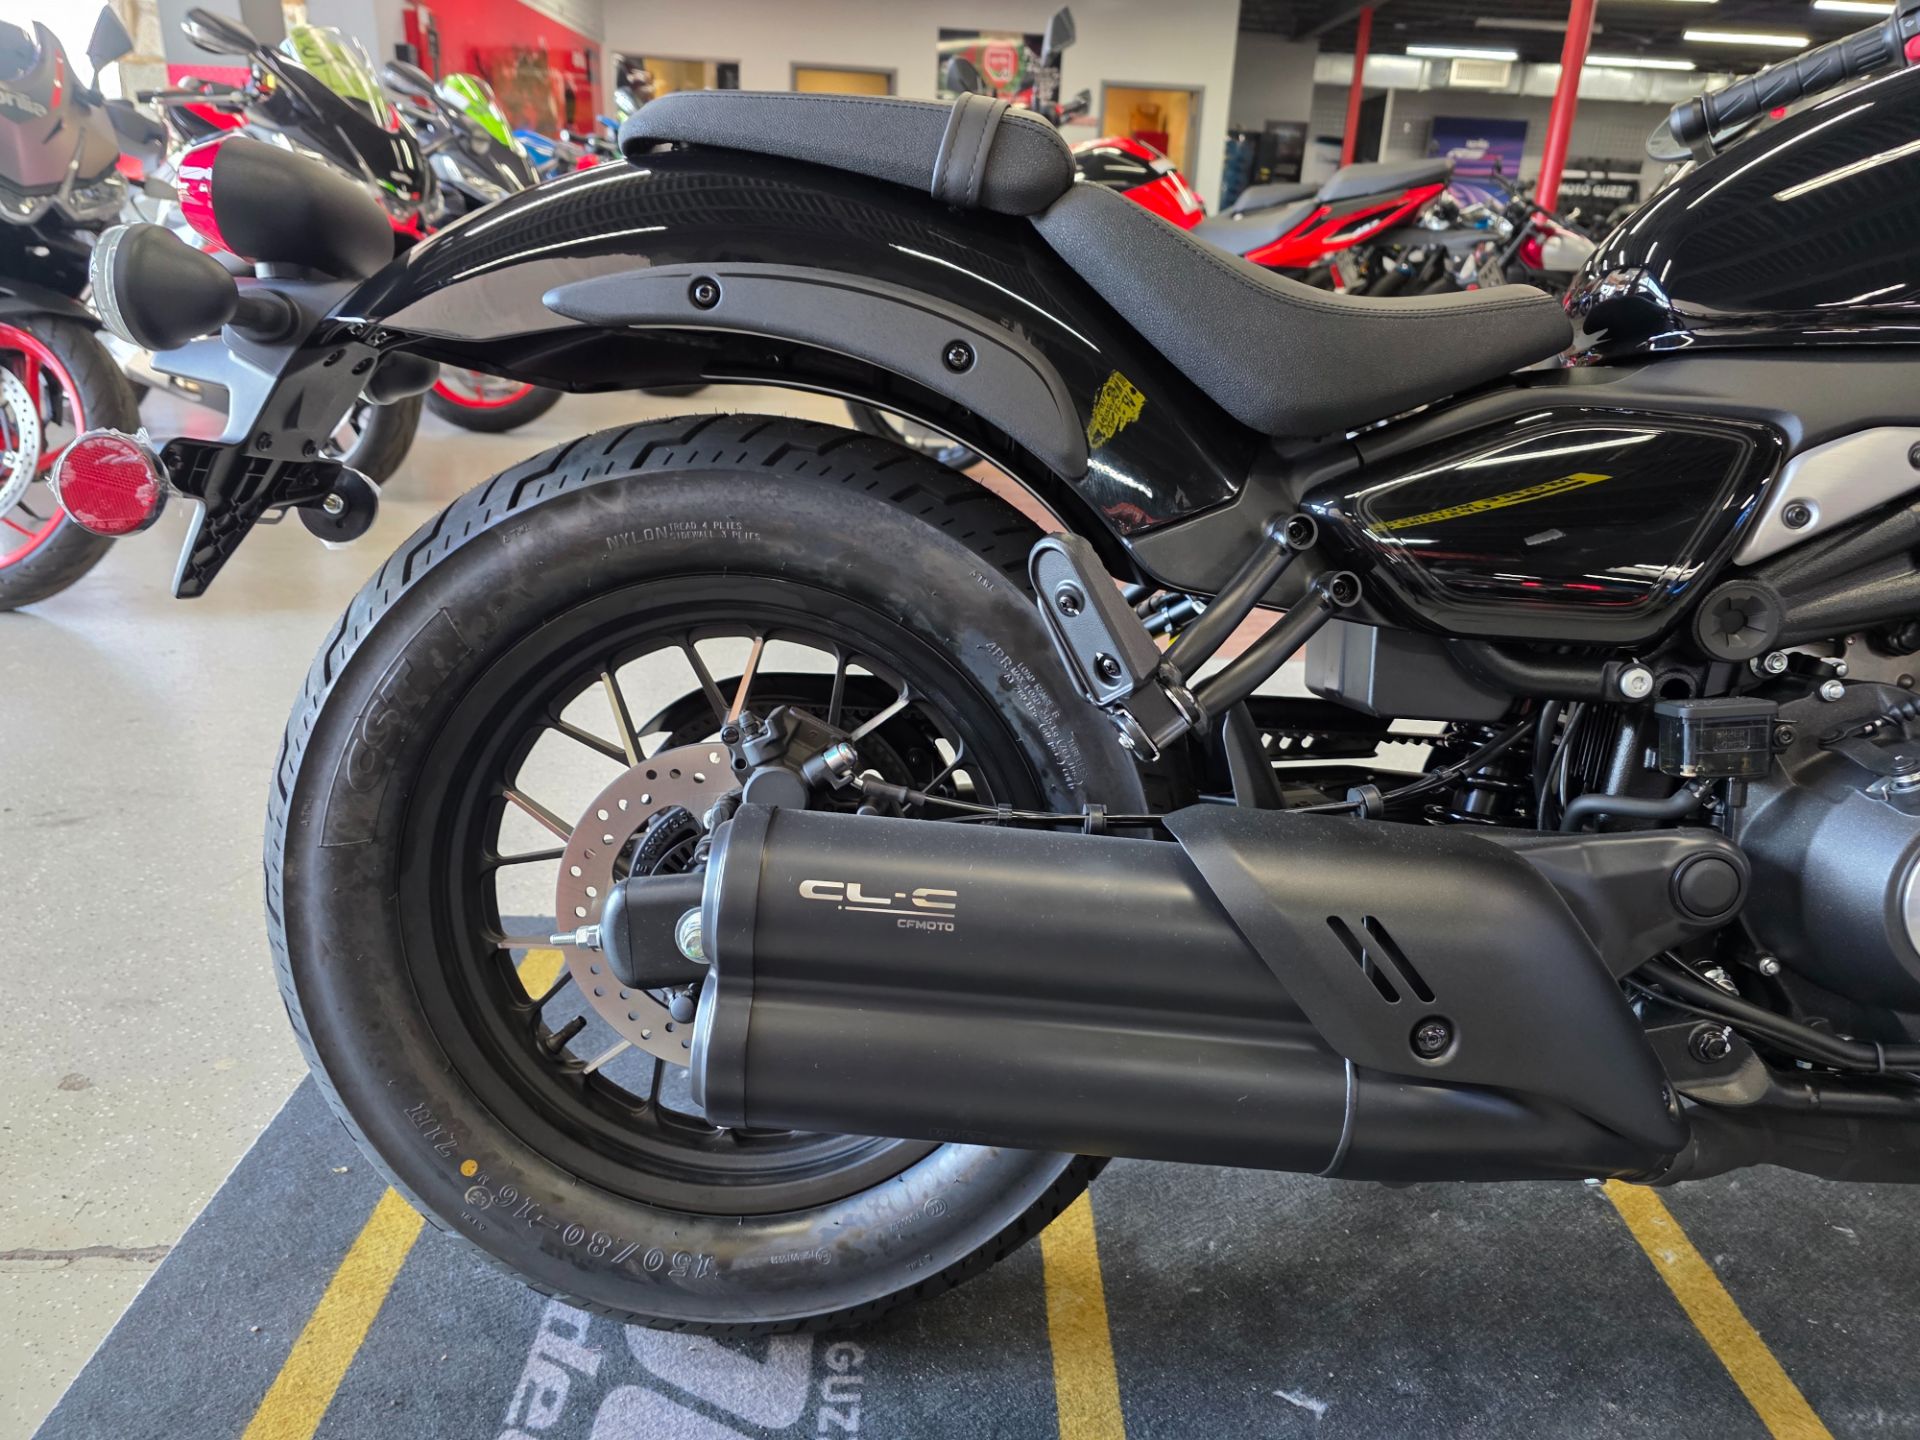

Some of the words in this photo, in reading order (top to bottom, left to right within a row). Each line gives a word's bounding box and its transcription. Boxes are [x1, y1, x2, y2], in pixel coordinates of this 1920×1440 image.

[669, 521, 697, 531] TREAD
[702, 521, 708, 529] 4
[713, 521, 742, 530] PLIES
[605, 526, 668, 550] NYLON
[669, 530, 713, 541] SIDEWALL
[732, 531, 761, 542] PLIES
[799, 879, 957, 910] CL-C
[896, 918, 955, 932] CFMOTO
[816, 1340, 866, 1440] GUZ
